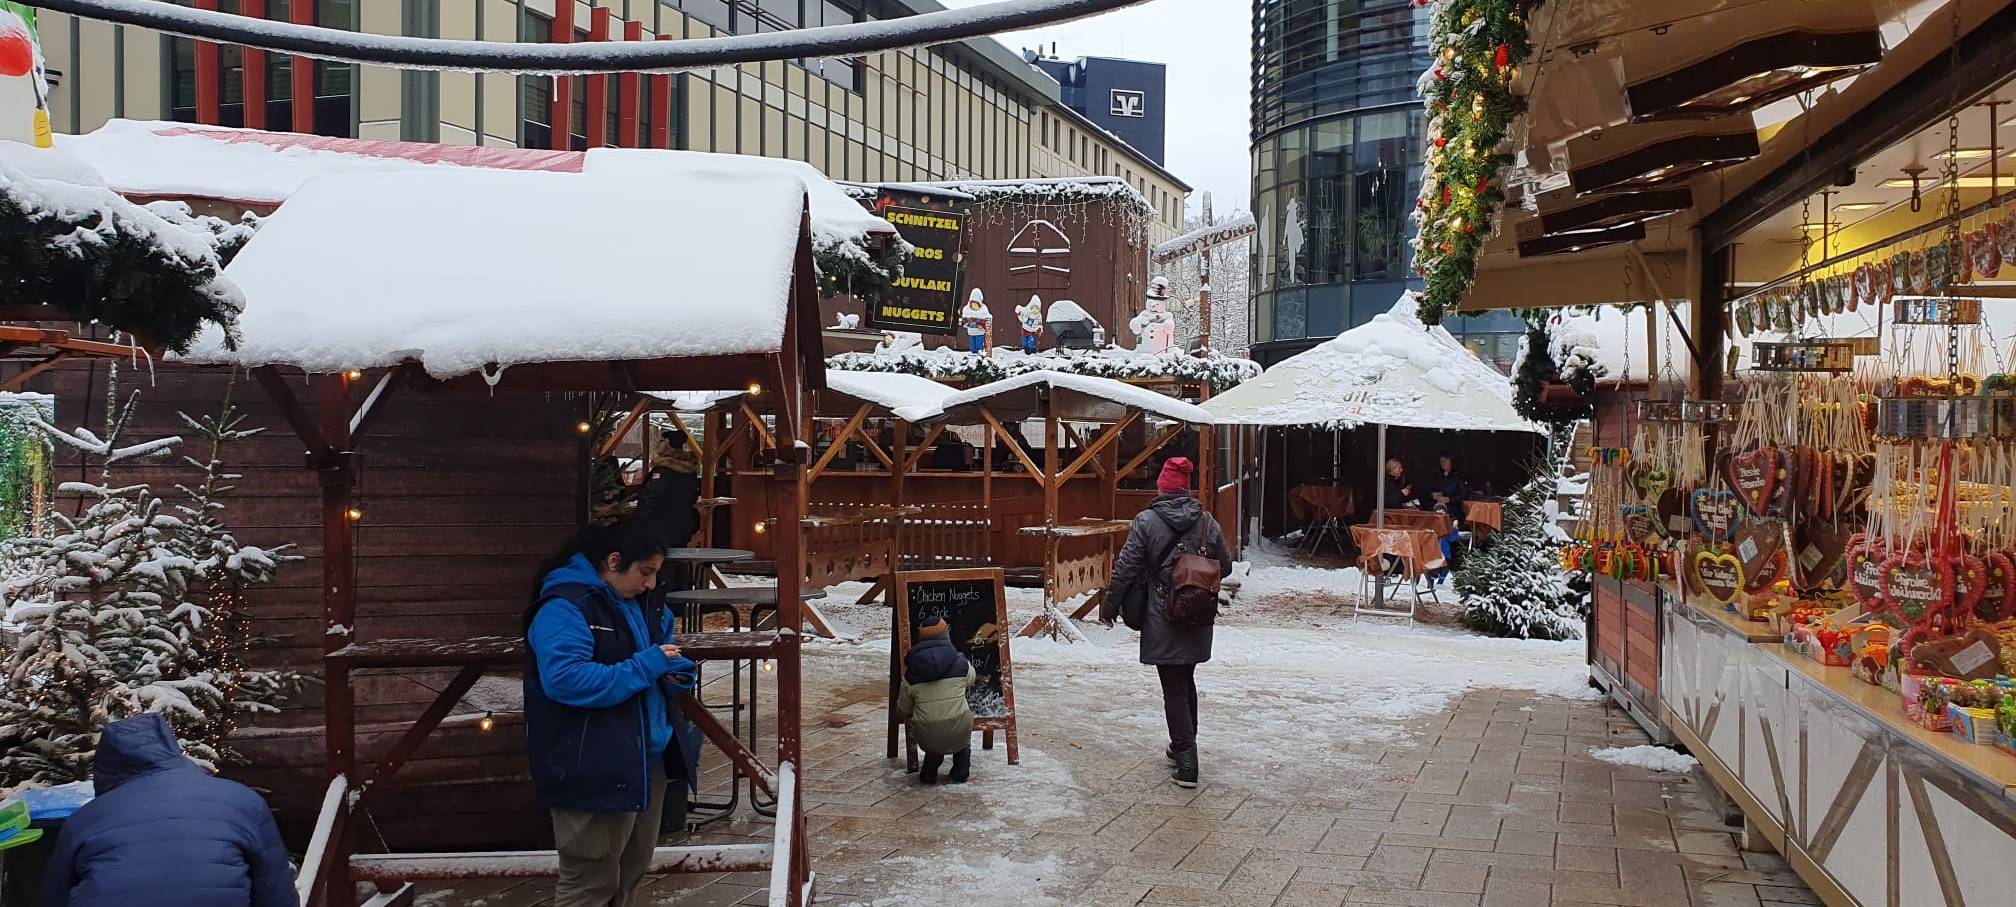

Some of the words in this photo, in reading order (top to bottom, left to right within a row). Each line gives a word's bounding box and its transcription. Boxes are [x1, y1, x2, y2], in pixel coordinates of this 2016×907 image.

[887, 211, 959, 231] SCHNITZEL
[914, 246, 943, 260] ROS
[890, 277, 951, 292] OUVLAKI
[882, 305, 945, 322] NUGGETS
[1894, 572, 1931, 589] Frohe
[917, 585, 946, 604] Chicken
[949, 585, 980, 606] Nuggets
